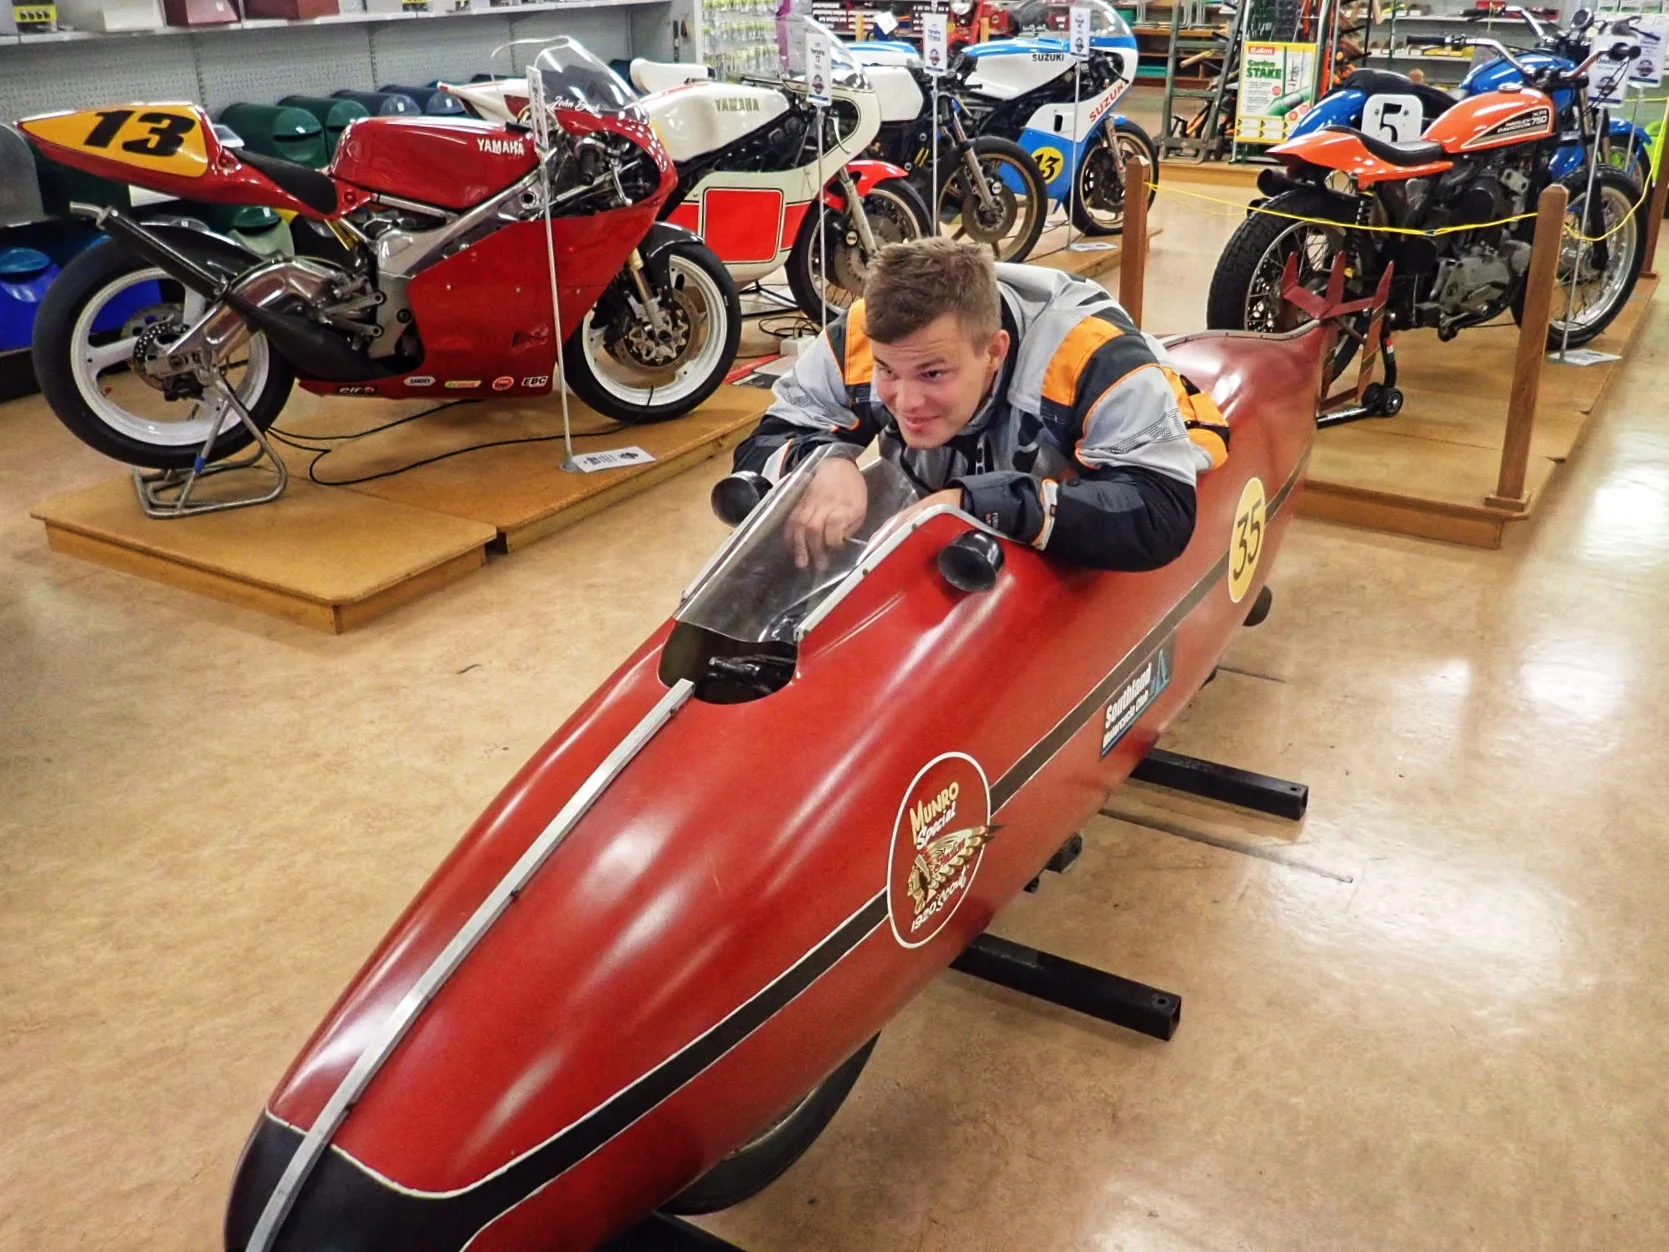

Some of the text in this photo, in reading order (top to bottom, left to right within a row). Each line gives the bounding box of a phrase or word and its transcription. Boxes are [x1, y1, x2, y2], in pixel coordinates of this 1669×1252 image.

[1246, 67, 1282, 79] STAKE
[714, 97, 760, 112] YAMAHA
[1088, 81, 1127, 122] SUZUK
[83, 109, 196, 157] 13
[1379, 102, 1403, 142] 5
[1531, 115, 1548, 125] 750
[477, 138, 524, 156] YAMAHA
[1034, 153, 1061, 180] 13
[523, 377, 547, 386] EBC
[1232, 498, 1262, 581] 35
[1105, 662, 1152, 729] Southland
[910, 781, 959, 846] MUNRO
[916, 801, 956, 850] Special
[910, 904, 936, 933] 1920
